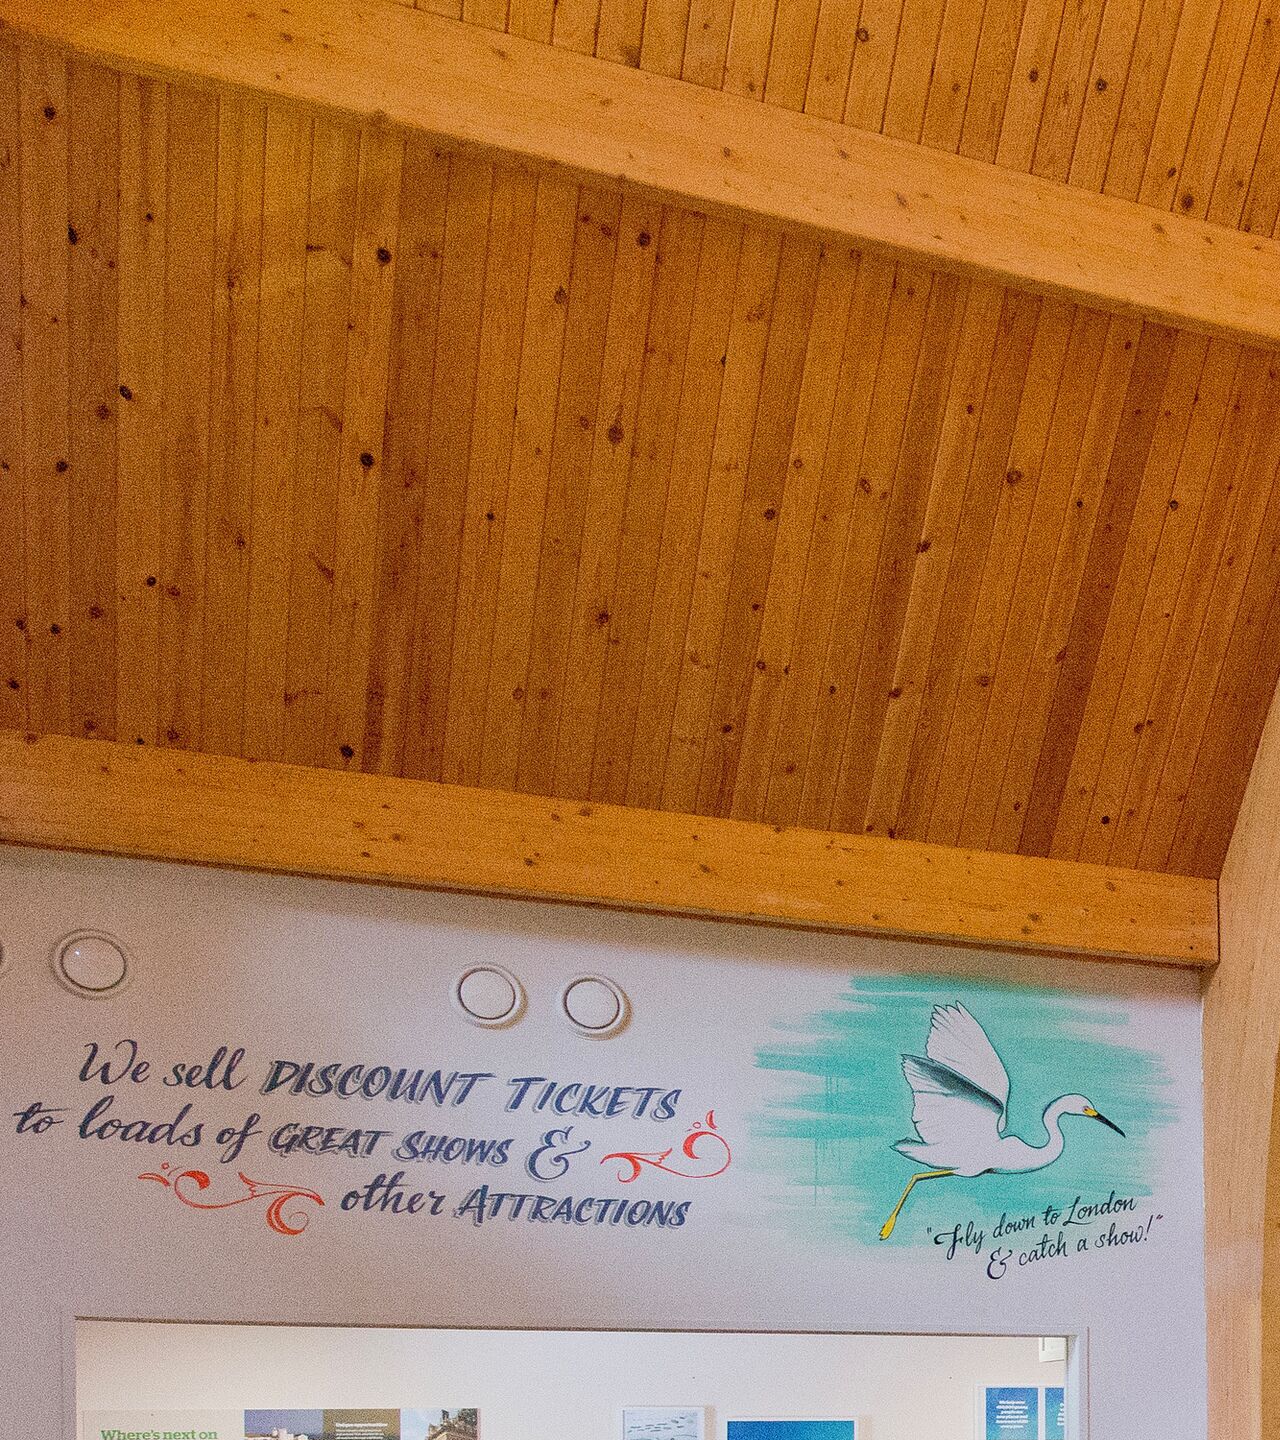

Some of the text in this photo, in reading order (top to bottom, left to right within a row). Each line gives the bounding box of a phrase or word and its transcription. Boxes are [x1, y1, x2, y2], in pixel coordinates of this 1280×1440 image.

[78, 1039, 683, 1123] We sell DISCOUNT TICKETS
[14, 1096, 593, 1182] to loads of GREAT SHOWS &
[340, 1171, 690, 1230] other ATTRACTIONS
[992, 1212, 1036, 1238] down
[1042, 1206, 1060, 1226] to
[1063, 1190, 1137, 1226] London
[987, 1247, 1012, 1280] &
[1019, 1232, 1068, 1266] catch
[1077, 1236, 1089, 1250] a
[101, 1430, 218, 1440] Where's next on
